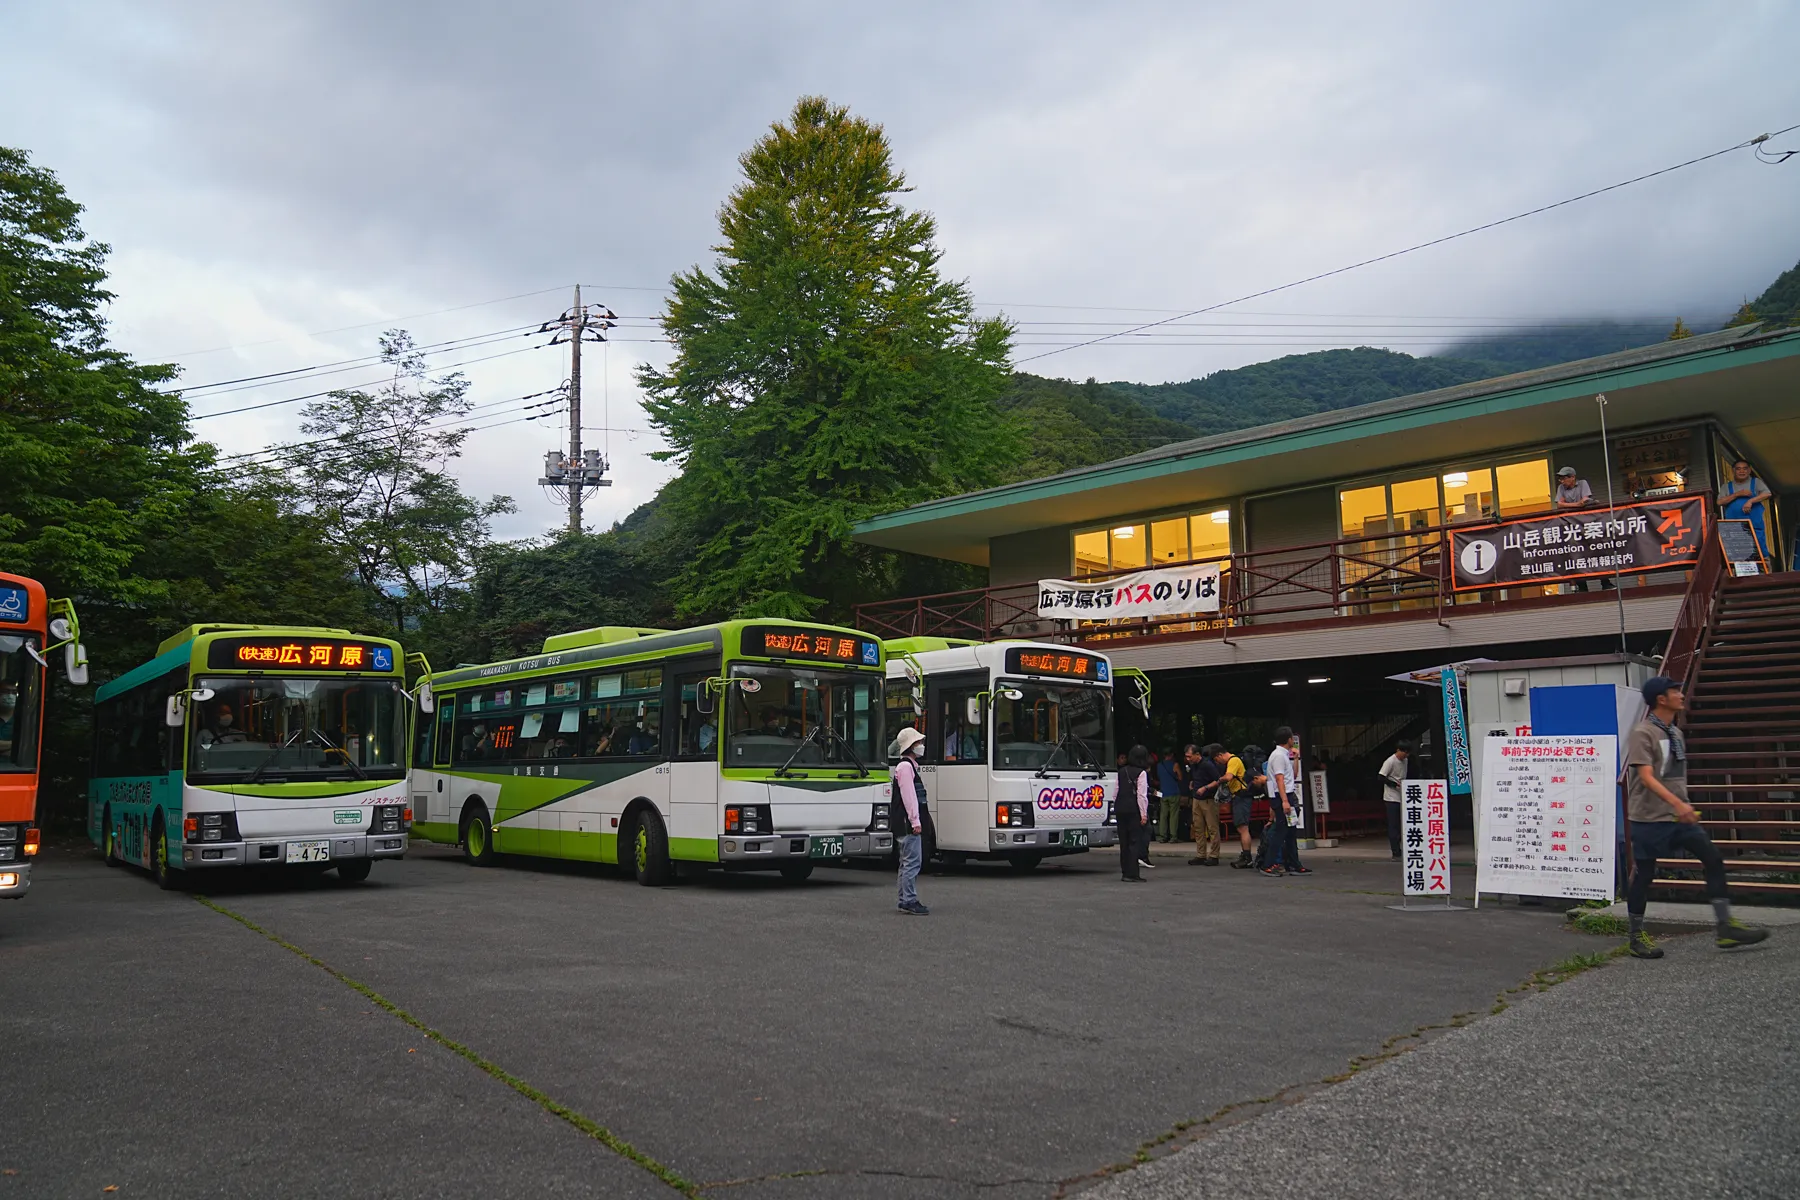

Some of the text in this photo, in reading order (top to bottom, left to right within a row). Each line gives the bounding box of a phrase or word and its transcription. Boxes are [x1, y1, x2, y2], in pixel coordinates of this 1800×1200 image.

[1503, 515, 1648, 550] 山岳観光案内所
[1522, 538, 1627, 558] information center
[1669, 544, 1697, 556] この上
[1520, 553, 1634, 576] 登山届・山岳情報案内
[1039, 575, 1218, 610] 広河原行バスのりば
[480, 656, 561, 677] YAMANASHI KOTSU BUS
[1501, 746, 1600, 757] 事前予約が必要です。
[1037, 784, 1104, 809] CCNet光
[1406, 784, 1425, 891] 乗車券売場
[1427, 783, 1446, 890] 広河原行バス
